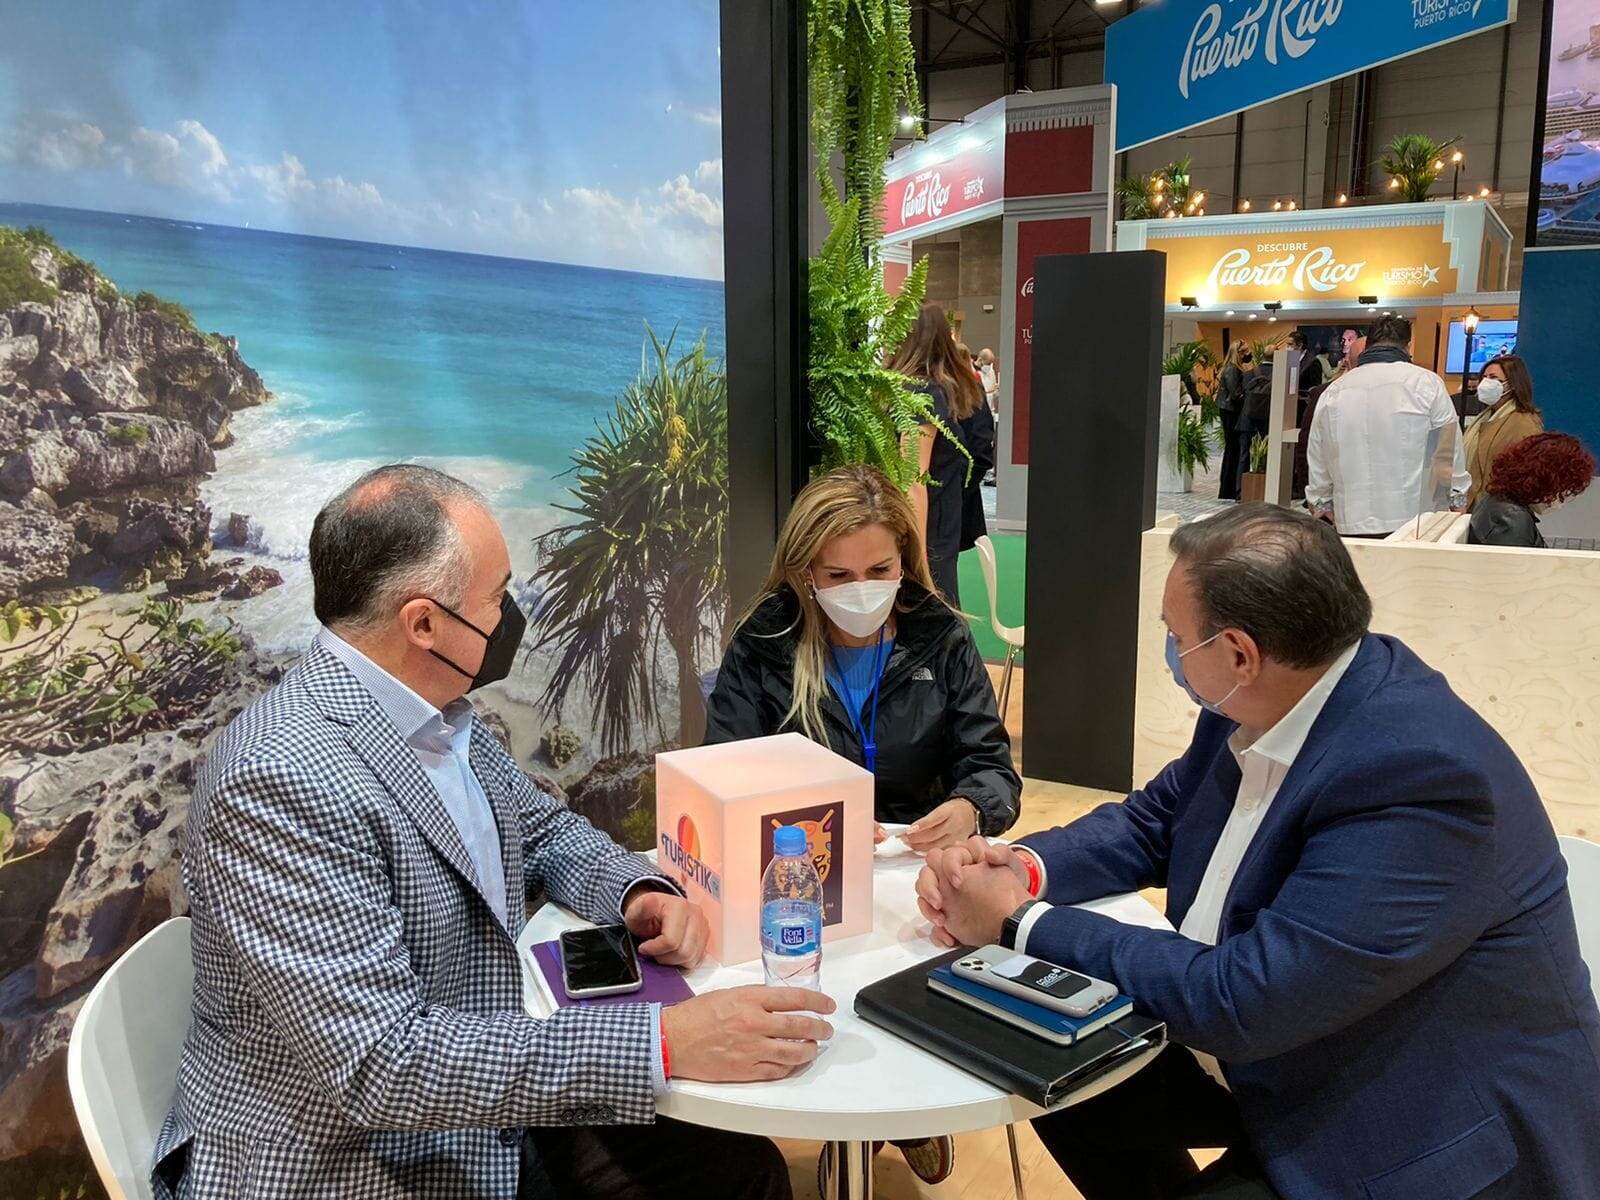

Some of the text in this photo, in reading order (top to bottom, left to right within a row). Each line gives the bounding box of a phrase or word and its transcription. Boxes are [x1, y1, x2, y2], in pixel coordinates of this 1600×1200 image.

[1414, 1, 1471, 29] PUERTO RICO
[1179, 0, 1343, 99] Puerto Rico
[928, 172, 951, 217] Rico
[1257, 242, 1309, 252] DESCUBRE
[1207, 246, 1367, 296] Puerto Rico
[661, 833, 712, 894] TURISTIK
[783, 928, 802, 936] Font
[783, 935, 803, 944] Vella
